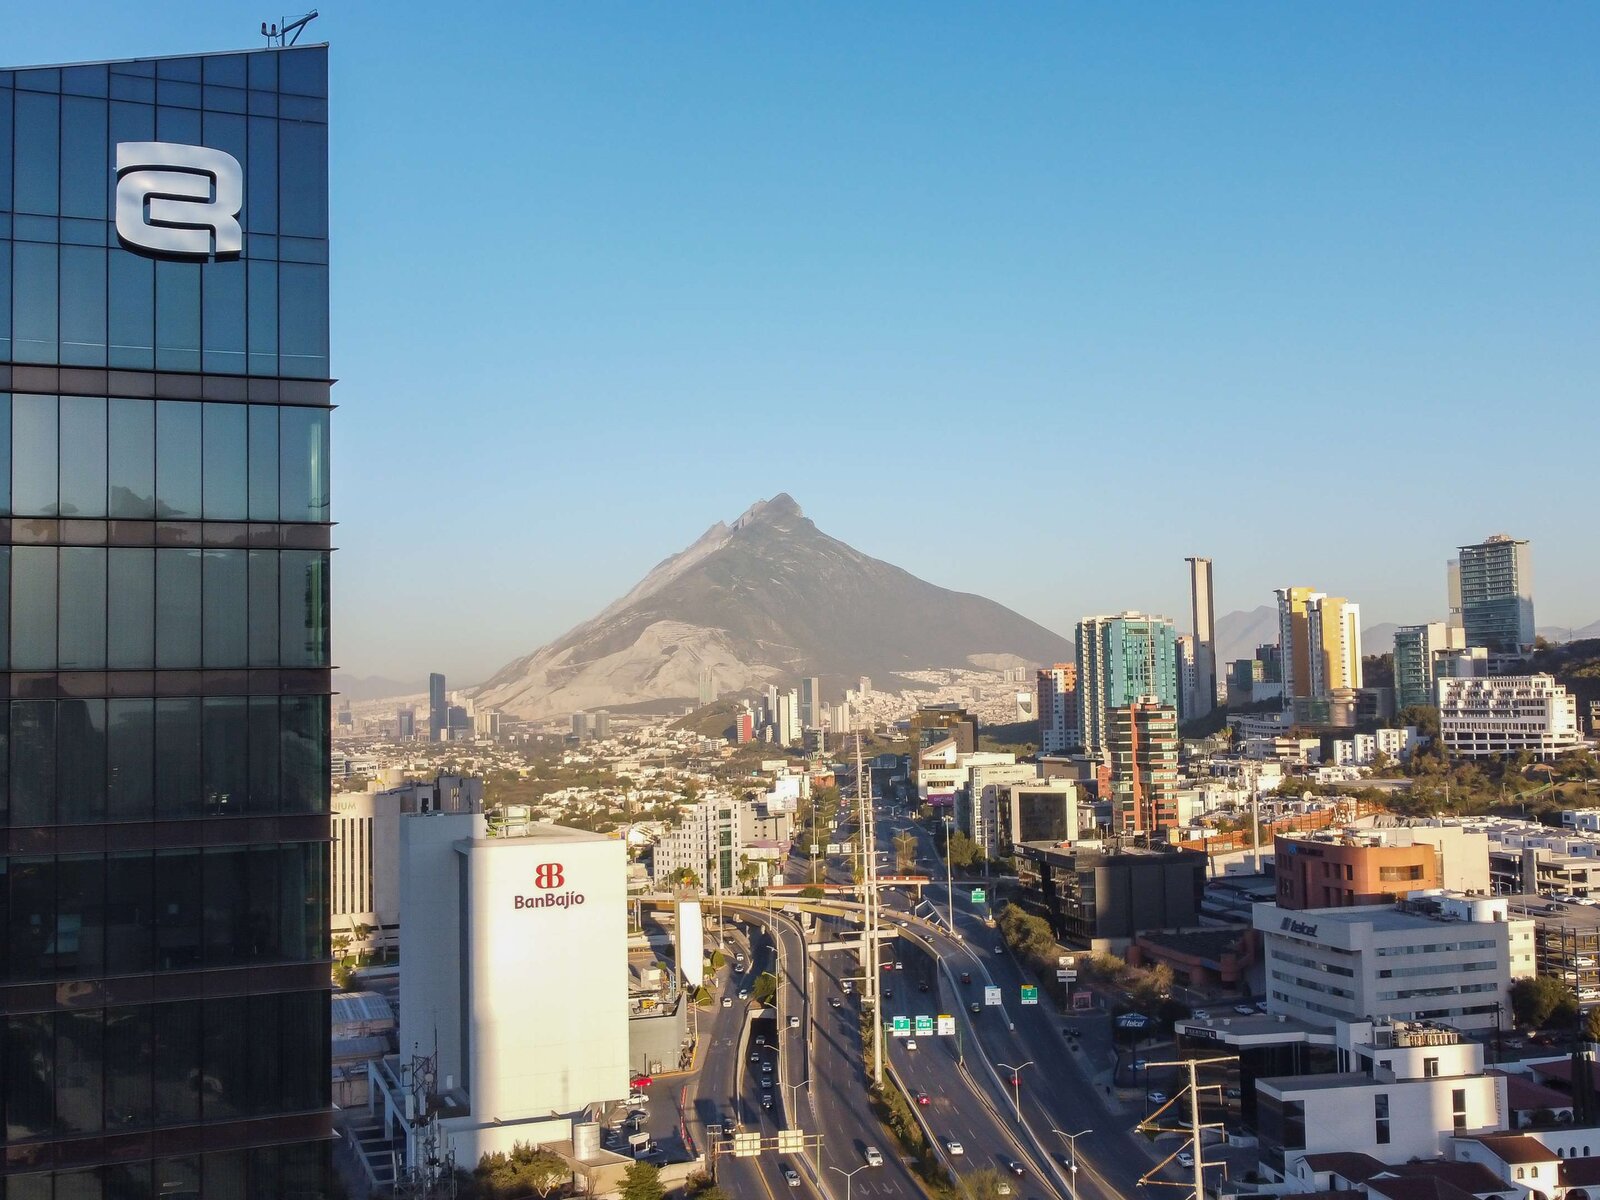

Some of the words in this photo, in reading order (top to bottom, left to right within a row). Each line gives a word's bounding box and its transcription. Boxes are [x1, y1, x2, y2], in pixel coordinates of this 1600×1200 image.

[514, 891, 585, 909] BanBajío
[1291, 920, 1318, 938] telcel
[1127, 1020, 1145, 1028] telcel
